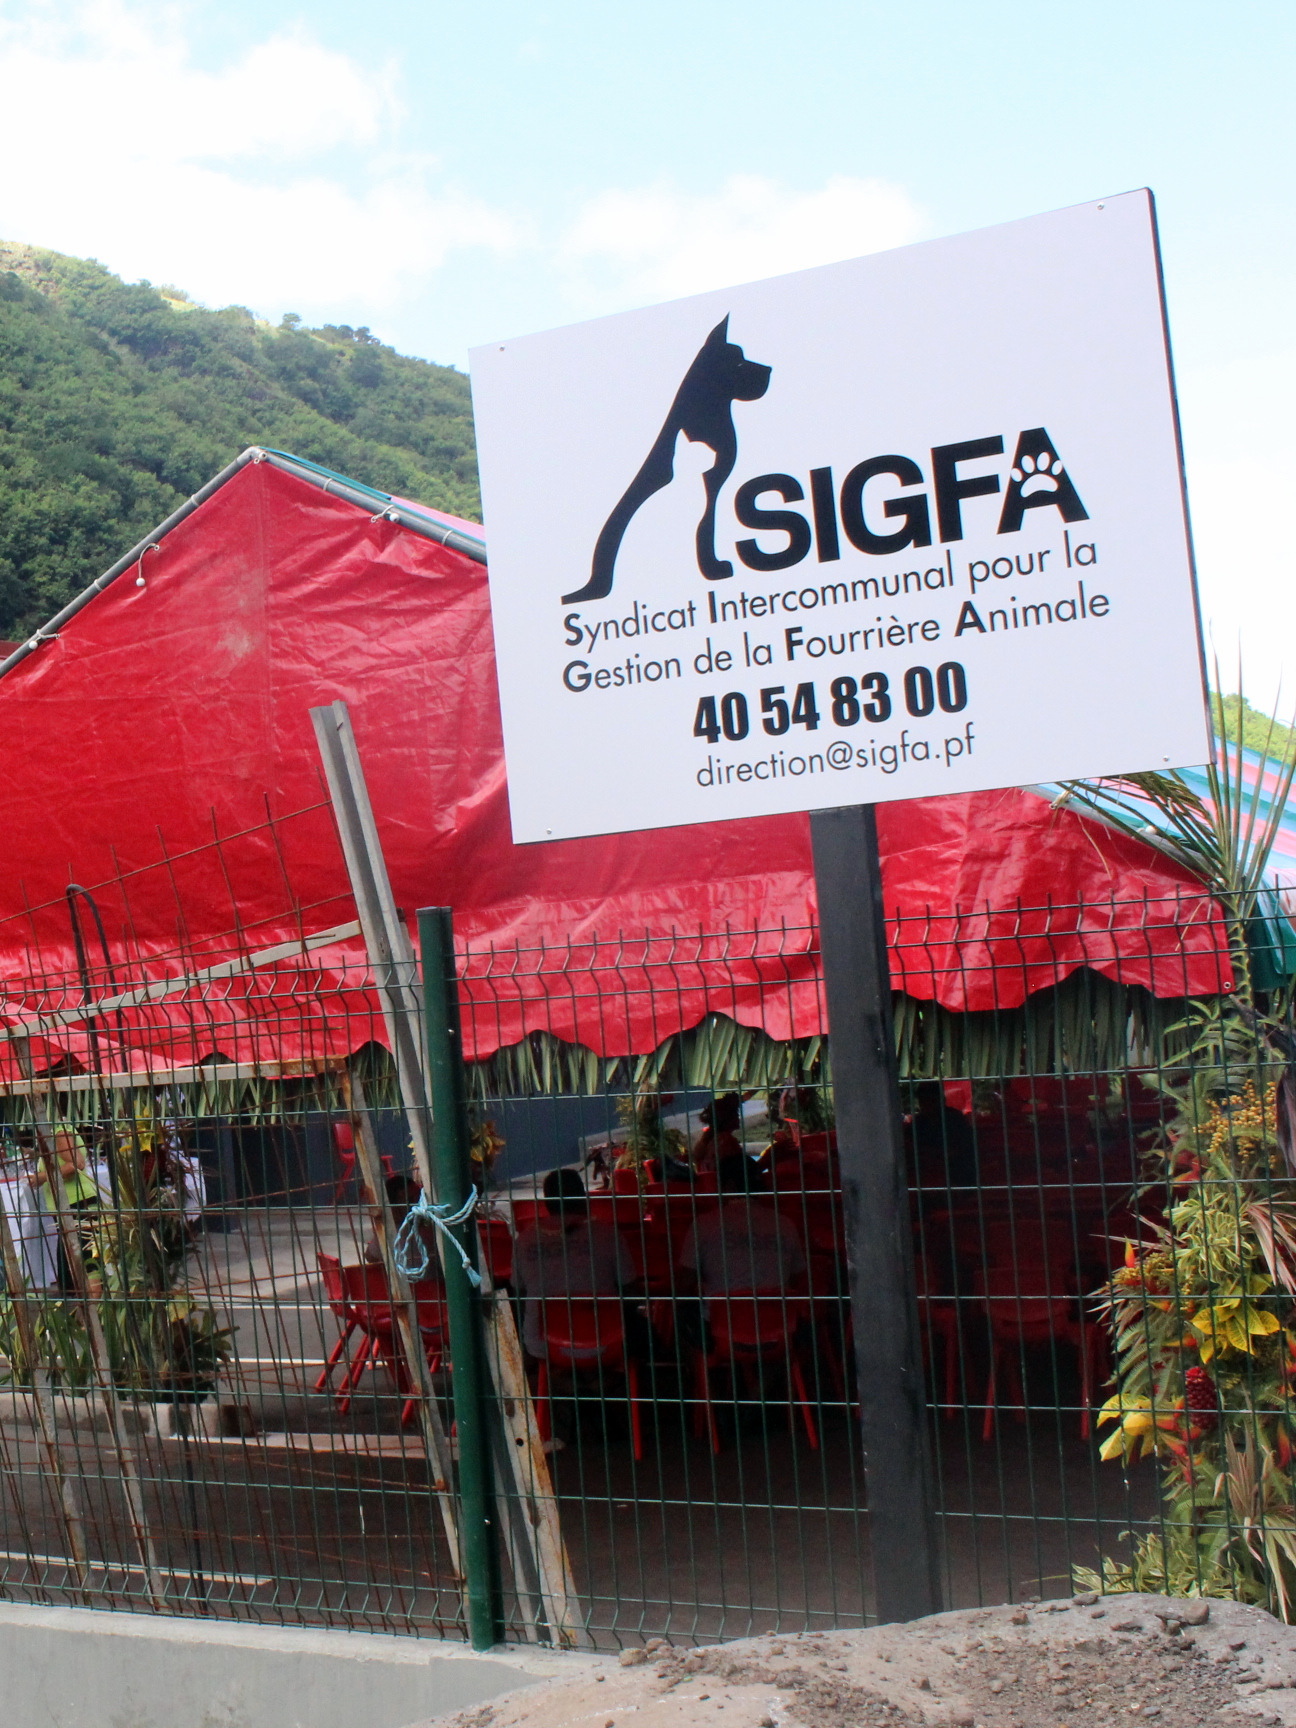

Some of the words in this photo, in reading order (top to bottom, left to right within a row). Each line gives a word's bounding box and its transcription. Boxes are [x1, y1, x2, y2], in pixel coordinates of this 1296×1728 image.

[734, 425, 1090, 572] SIGFA
[562, 653, 682, 693] Gestion
[693, 637, 733, 675] de
[743, 631, 773, 668] la
[784, 615, 940, 662] Fourrière
[954, 580, 1110, 637] Animale
[563, 600, 697, 654] Syndicat
[708, 549, 954, 624] Intercommunal
[968, 549, 1051, 595] pour
[1063, 529, 1097, 568] la
[693, 691, 750, 744] 40
[760, 681, 821, 736] 54
[830, 671, 892, 727] 83
[903, 661, 968, 718] 00
[696, 721, 975, 787] direction@sigfa.pf
